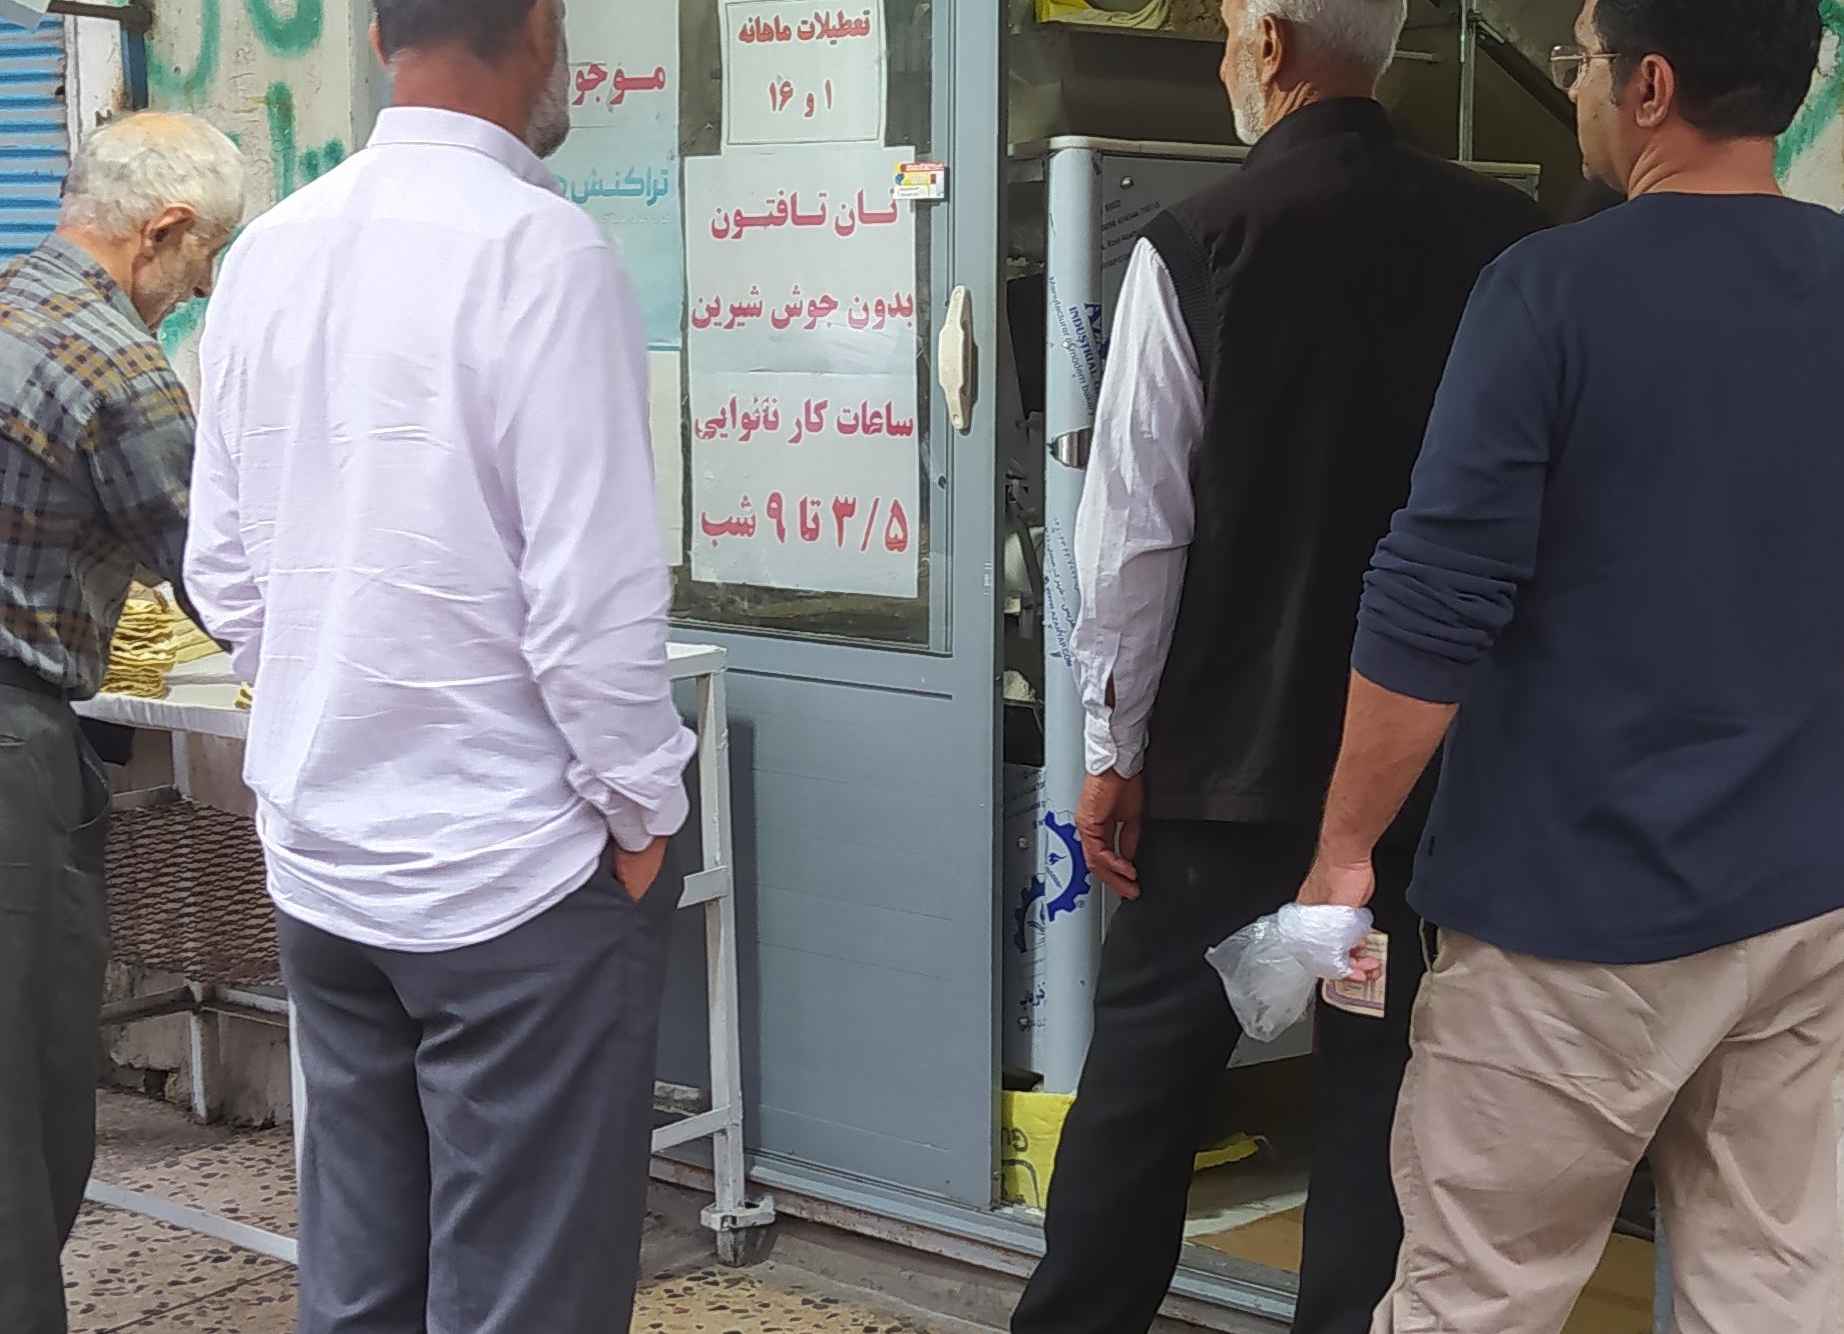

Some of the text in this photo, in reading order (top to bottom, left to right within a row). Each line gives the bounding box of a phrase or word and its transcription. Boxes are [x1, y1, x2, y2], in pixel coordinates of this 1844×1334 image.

[738, 10, 871, 45] تعطیلات ماهانه
[572, 62, 666, 105] موجو
[768, 79, 794, 112] ۱۶
[804, 92, 815, 117] و
[571, 166, 669, 206] تراکنش
[711, 188, 899, 239] نان تافتون
[691, 285, 914, 329] بدون جوش شیرین
[694, 396, 914, 444] ساعات کار نانوایی
[700, 495, 757, 548] شب
[765, 490, 786, 544] ۹
[799, 496, 821, 542] تا
